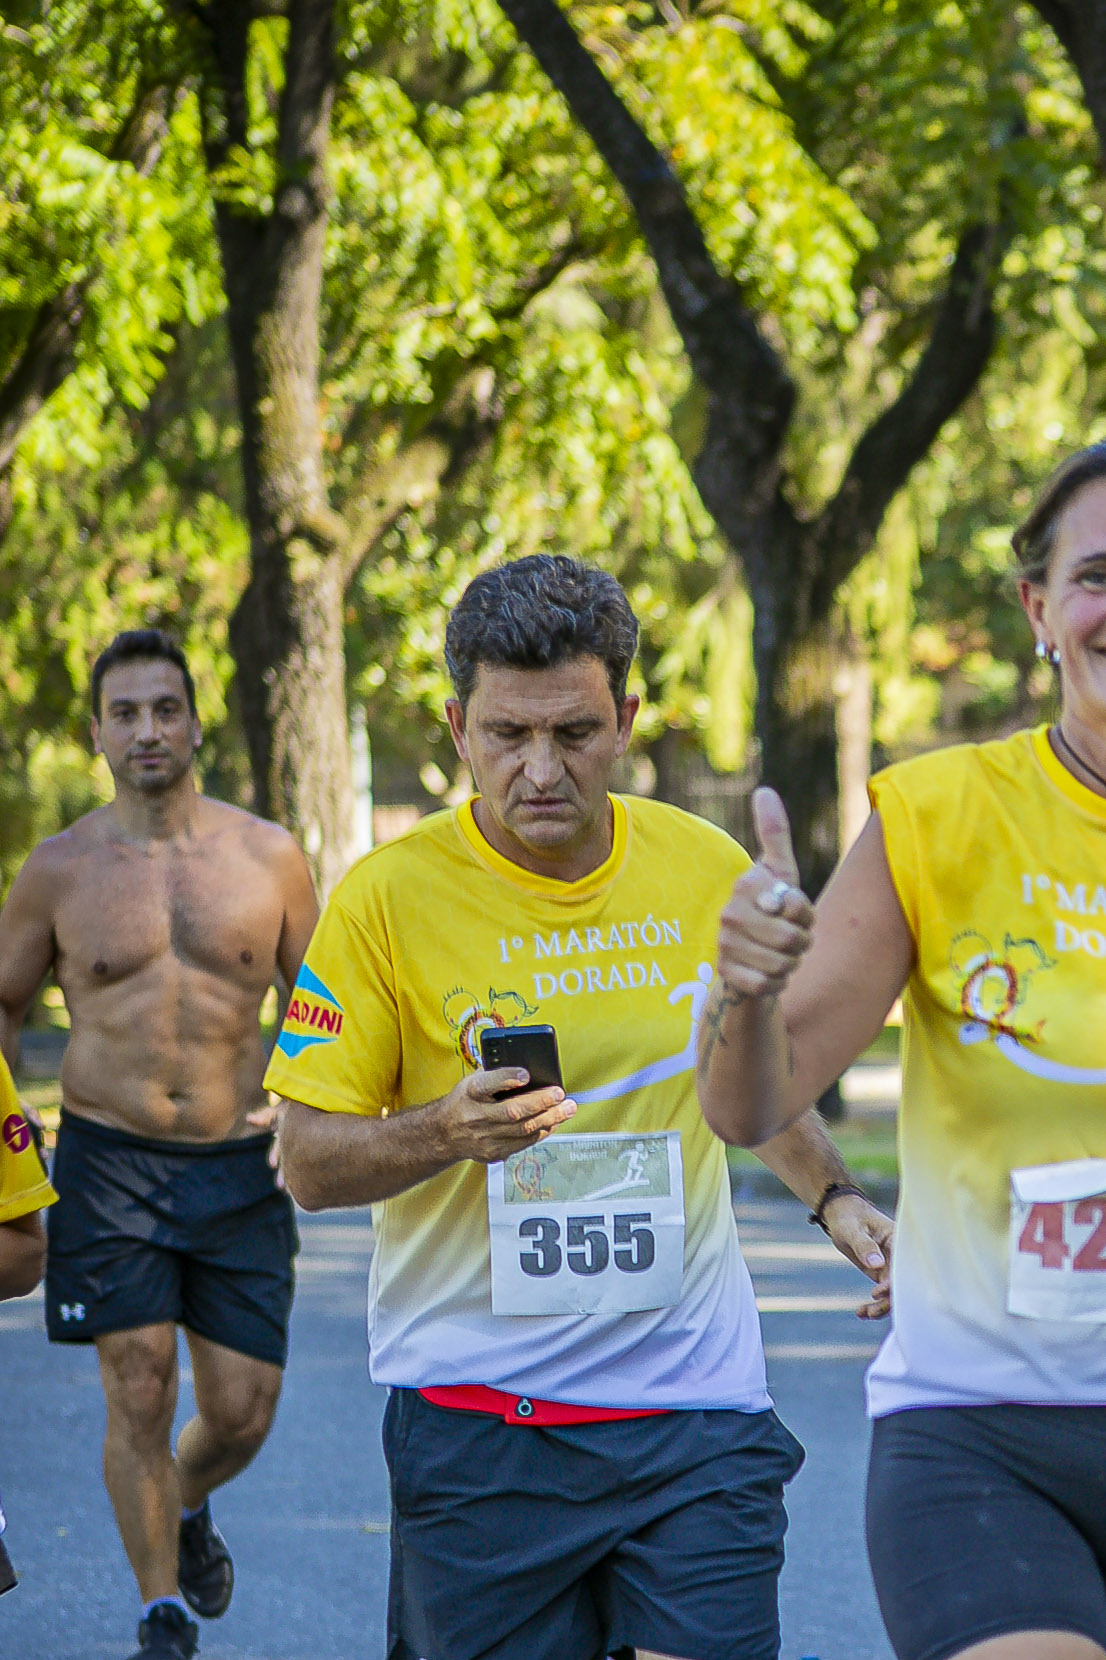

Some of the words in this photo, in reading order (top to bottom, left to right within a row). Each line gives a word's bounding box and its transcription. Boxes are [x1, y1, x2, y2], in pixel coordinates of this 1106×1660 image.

[533, 912, 683, 960] MARATÓN
[532, 960, 668, 1000] DORADA
[518, 1212, 656, 1277] 355
